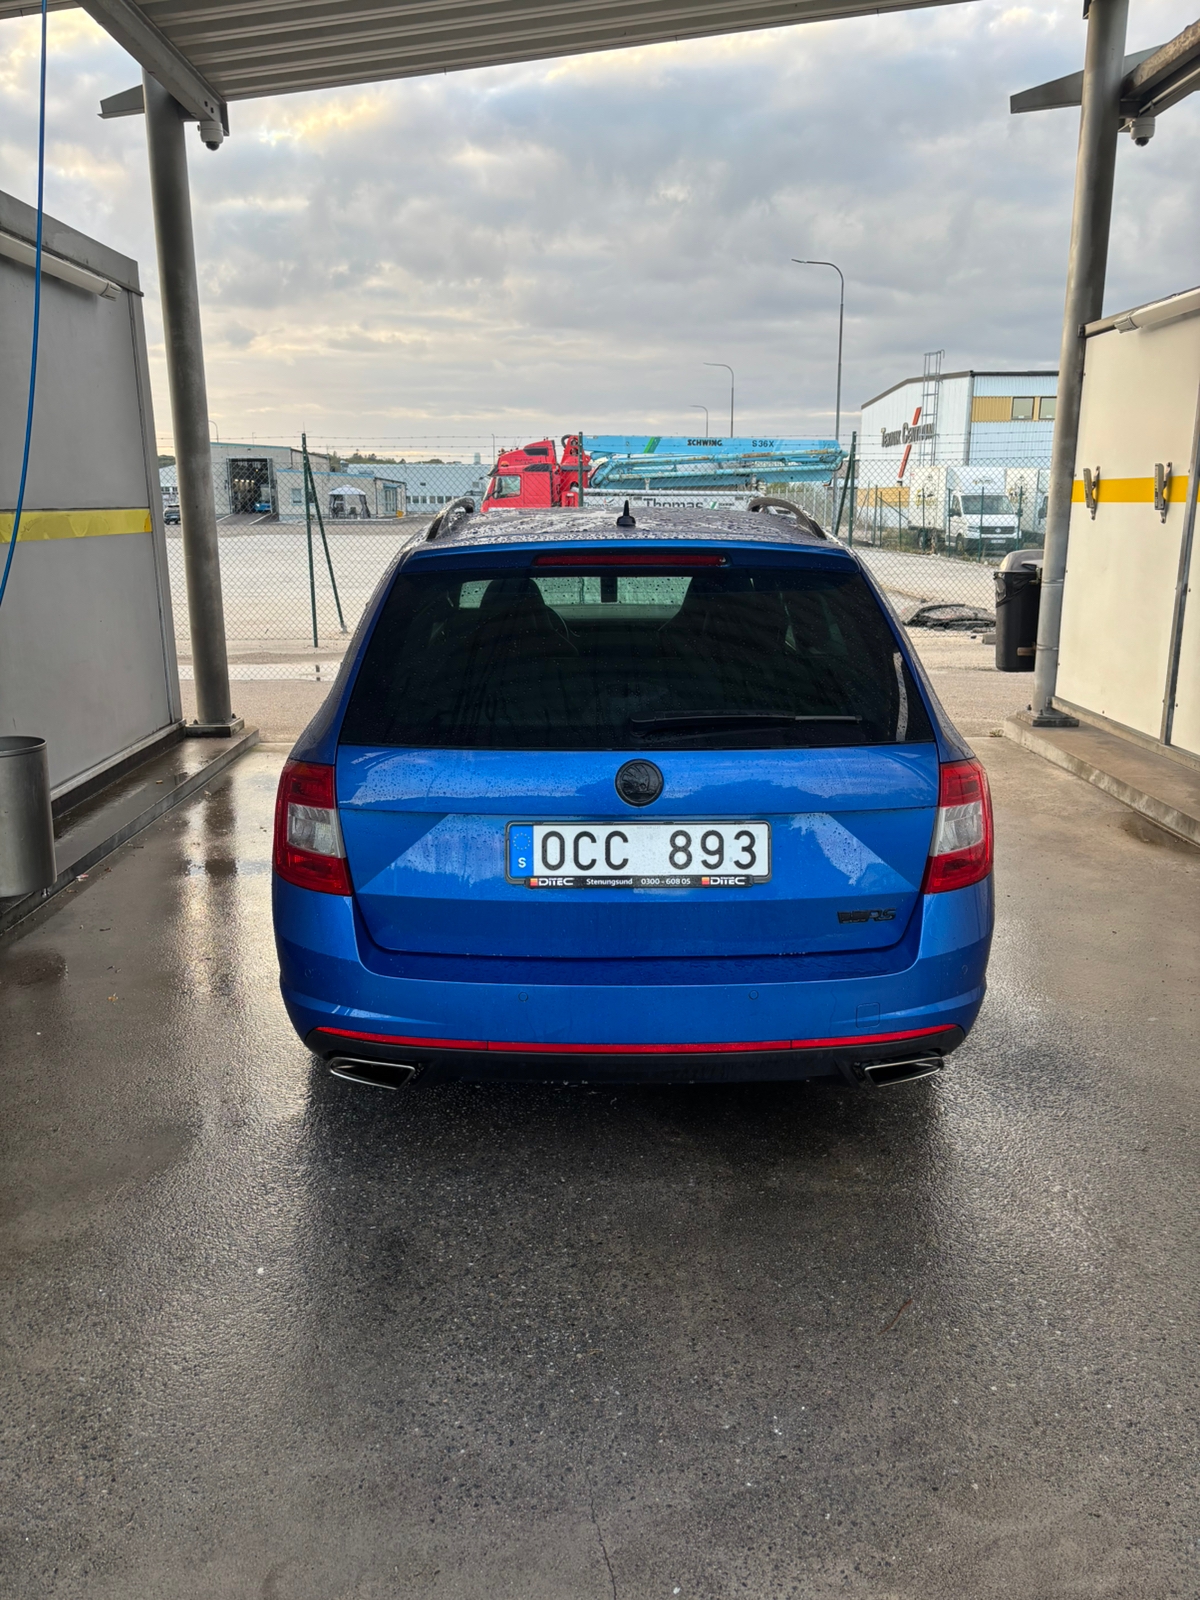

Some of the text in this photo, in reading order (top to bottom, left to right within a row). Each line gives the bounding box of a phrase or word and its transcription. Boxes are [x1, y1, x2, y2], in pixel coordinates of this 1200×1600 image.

[686, 438, 723, 447] SCHWING
[668, 829, 757, 870] 893
[517, 857, 527, 868] S
[586, 878, 633, 886] Stenungsund
